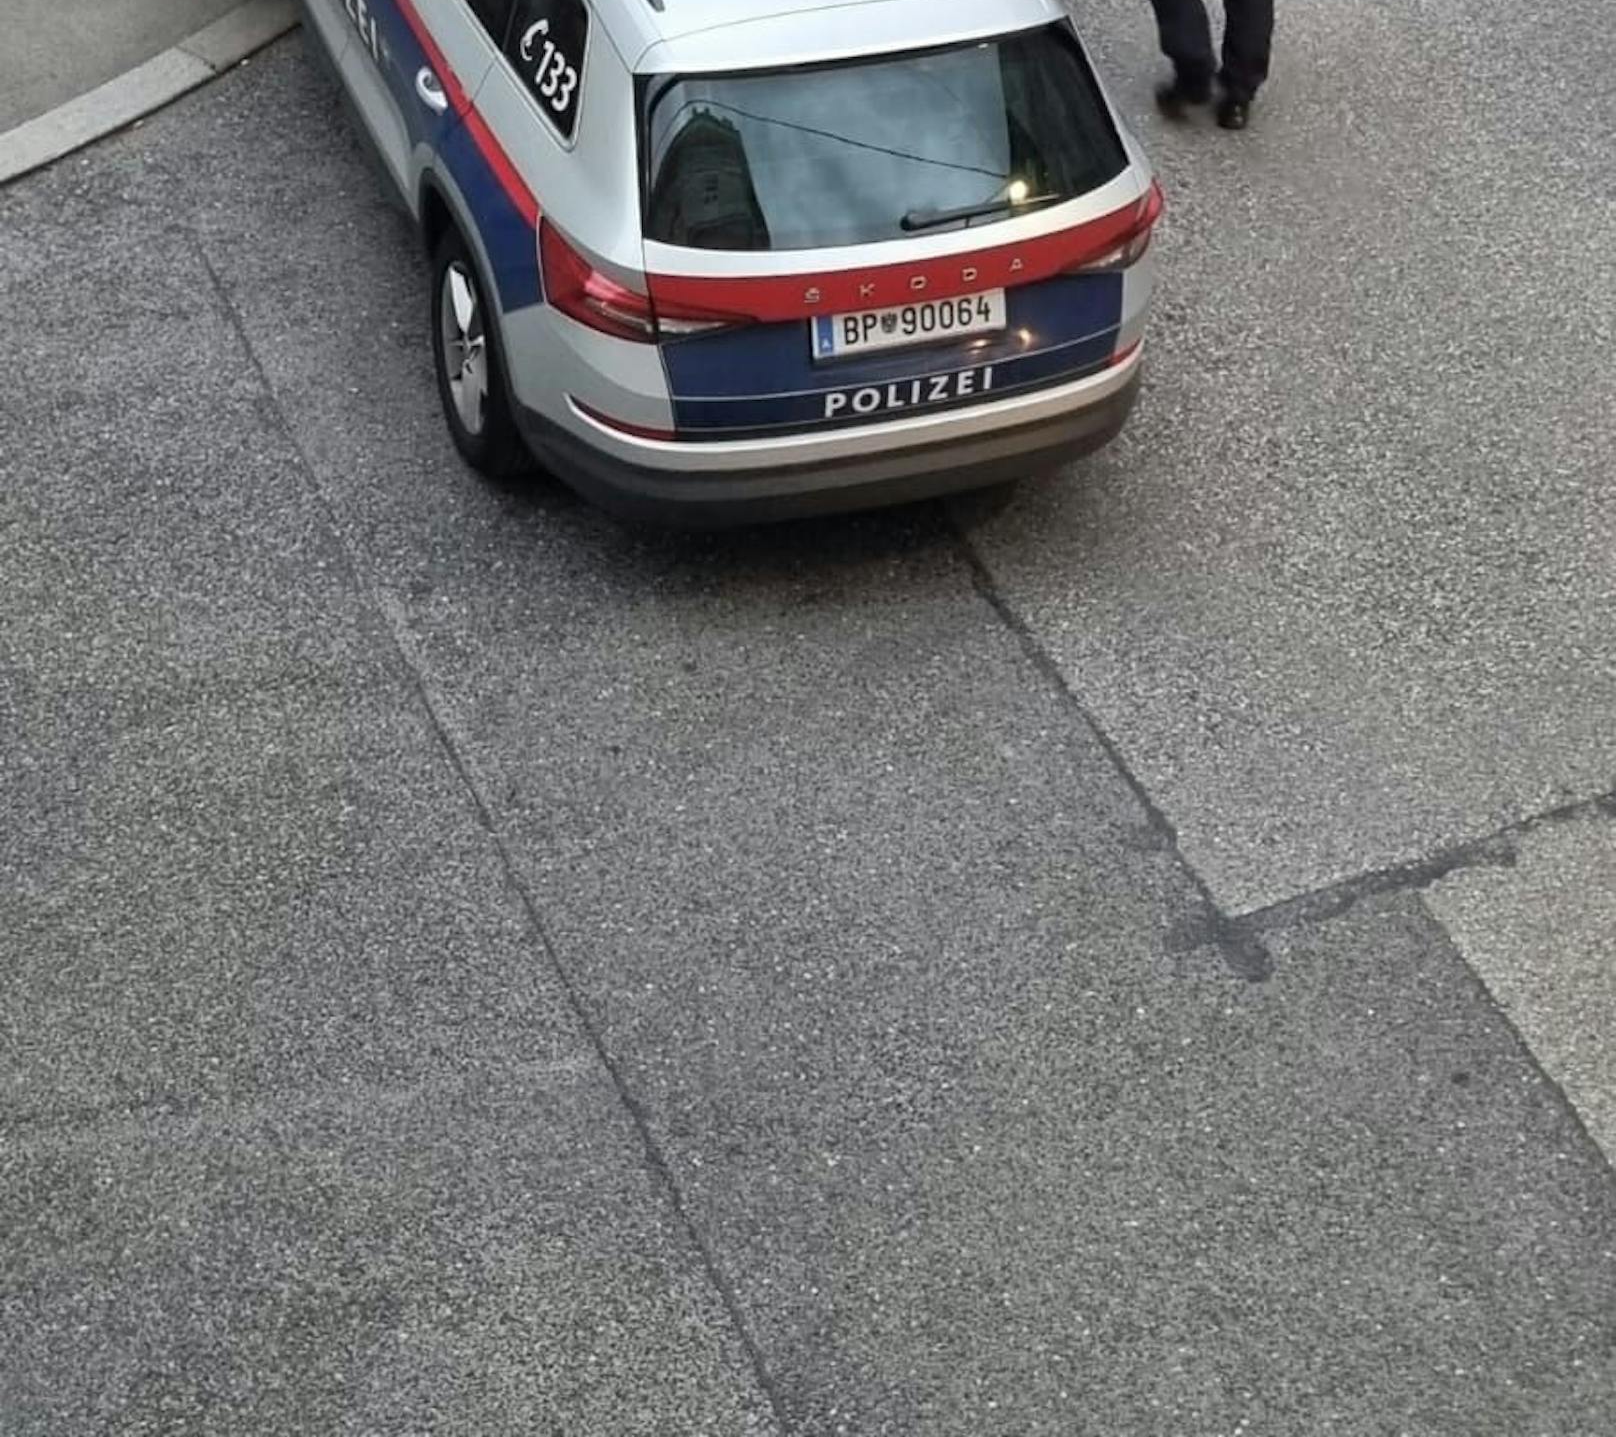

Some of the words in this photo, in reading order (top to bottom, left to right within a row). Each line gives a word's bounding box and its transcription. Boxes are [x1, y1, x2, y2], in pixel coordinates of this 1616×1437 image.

[535, 40, 578, 112] 133
[804, 258, 1024, 303] SKODA
[844, 315, 877, 346] BP
[901, 295, 991, 336] 90064
[824, 366, 993, 418] POLIZEI
